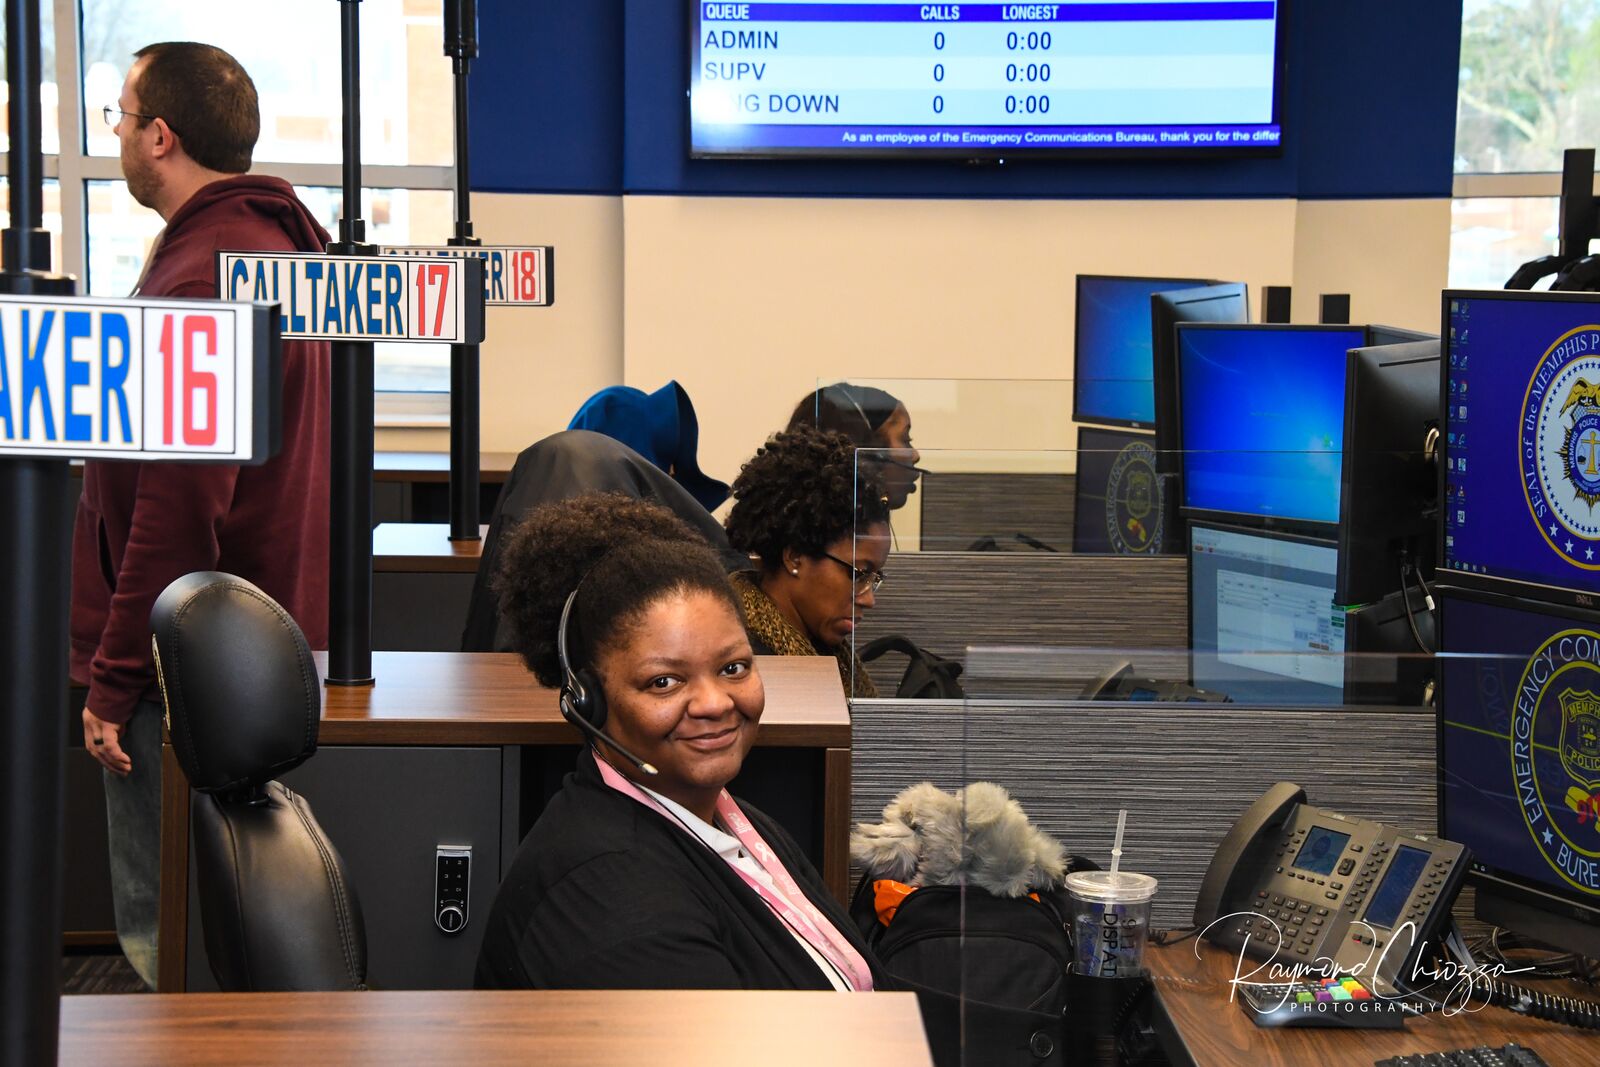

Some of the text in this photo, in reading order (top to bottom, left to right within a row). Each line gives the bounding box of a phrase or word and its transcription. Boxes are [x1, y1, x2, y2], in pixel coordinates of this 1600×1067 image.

[706, 4, 1059, 20] QUEUE CALLS LONGEST
[704, 30, 1051, 50] ADMIN 0 0:00
[704, 62, 1051, 82] SUPV 0 0:00
[769, 94, 839, 113] DOWN
[933, 95, 944, 113] 0
[1005, 95, 1050, 113] 0:00
[842, 130, 1280, 144] As an employee of the Emergency Communications Bureau, thank you for the differ
[512, 251, 536, 301] 18
[230, 258, 404, 336] CALLTAKER
[416, 263, 450, 337] 17
[159, 313, 217, 446] 16
[1532, 334, 1588, 400] MEMPHIS
[1525, 404, 1538, 431] the
[1579, 417, 1598, 430] POLICE
[1523, 437, 1534, 459] of
[1525, 464, 1547, 518] SEAL
[1514, 646, 1555, 824] EMERGENCY
[1556, 842, 1600, 888] BURE
